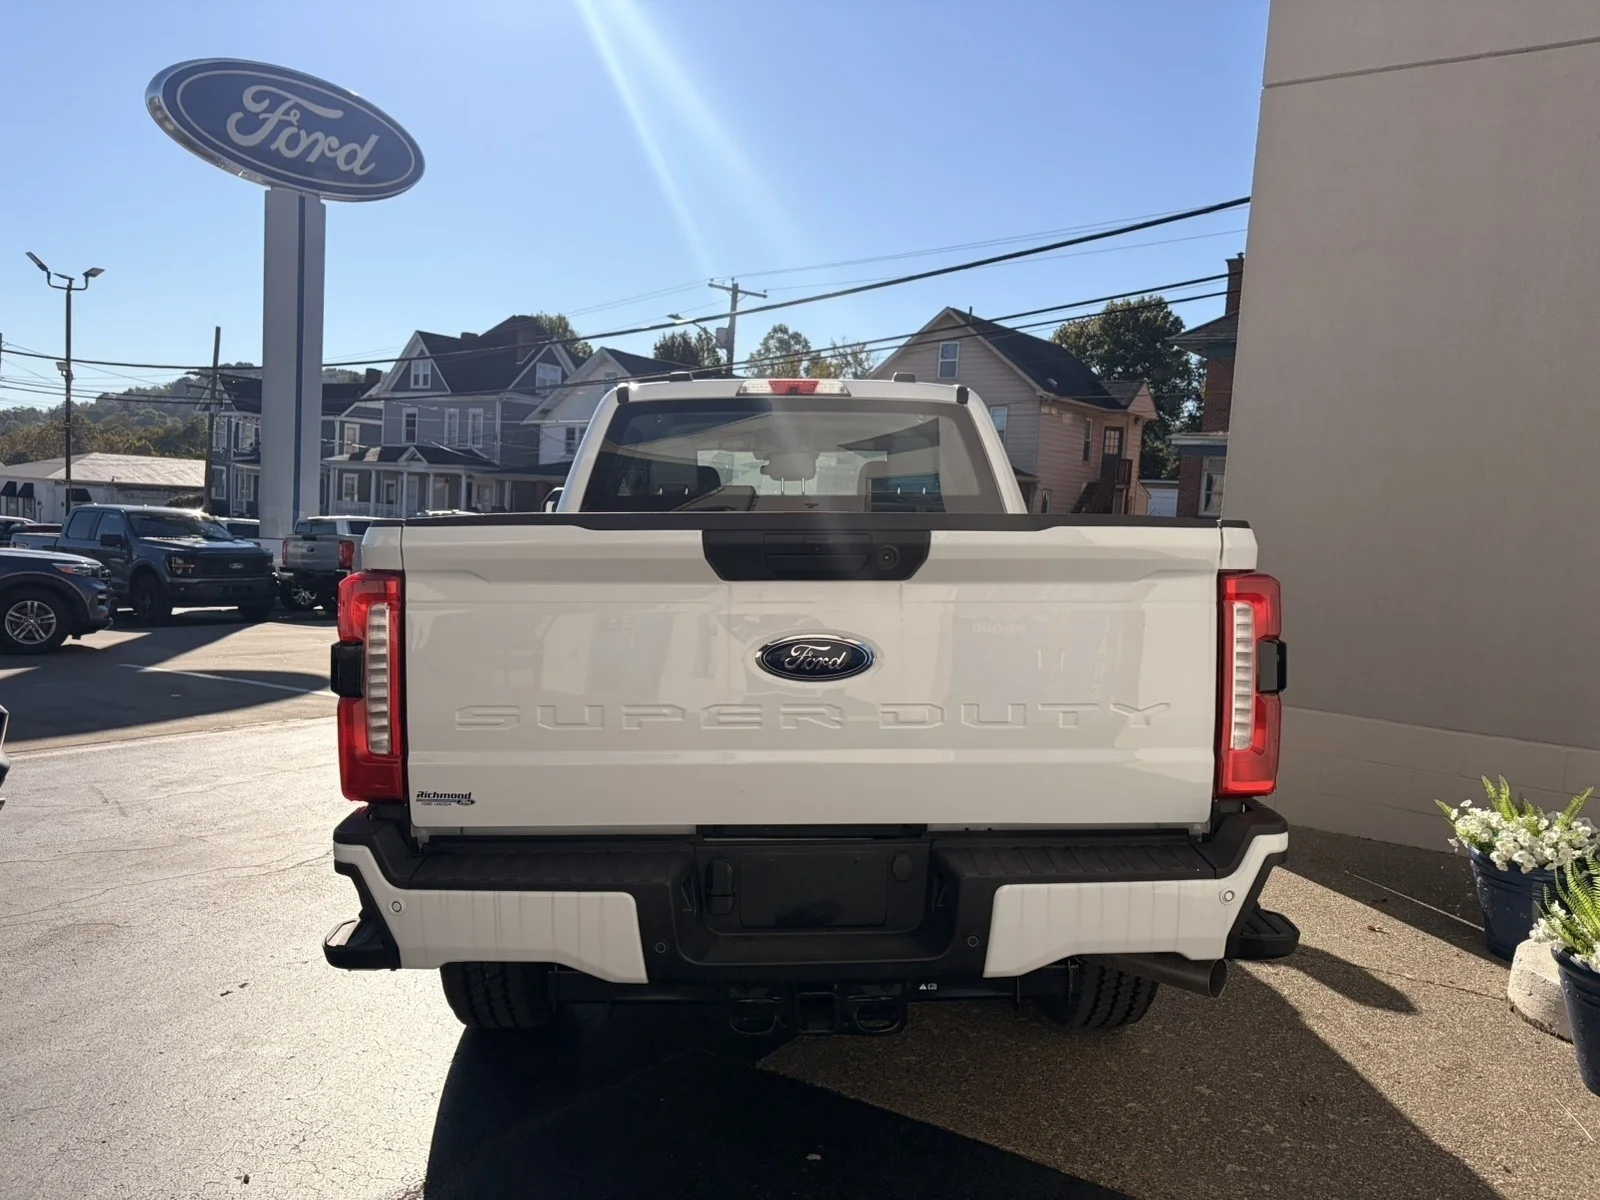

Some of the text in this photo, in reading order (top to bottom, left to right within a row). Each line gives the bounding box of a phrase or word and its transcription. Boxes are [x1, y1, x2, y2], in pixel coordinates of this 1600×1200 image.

[226, 84, 380, 176] Ford
[784, 644, 847, 671] Ford
[454, 702, 1171, 730] SUPER DUTY
[417, 791, 471, 799] Richmond
